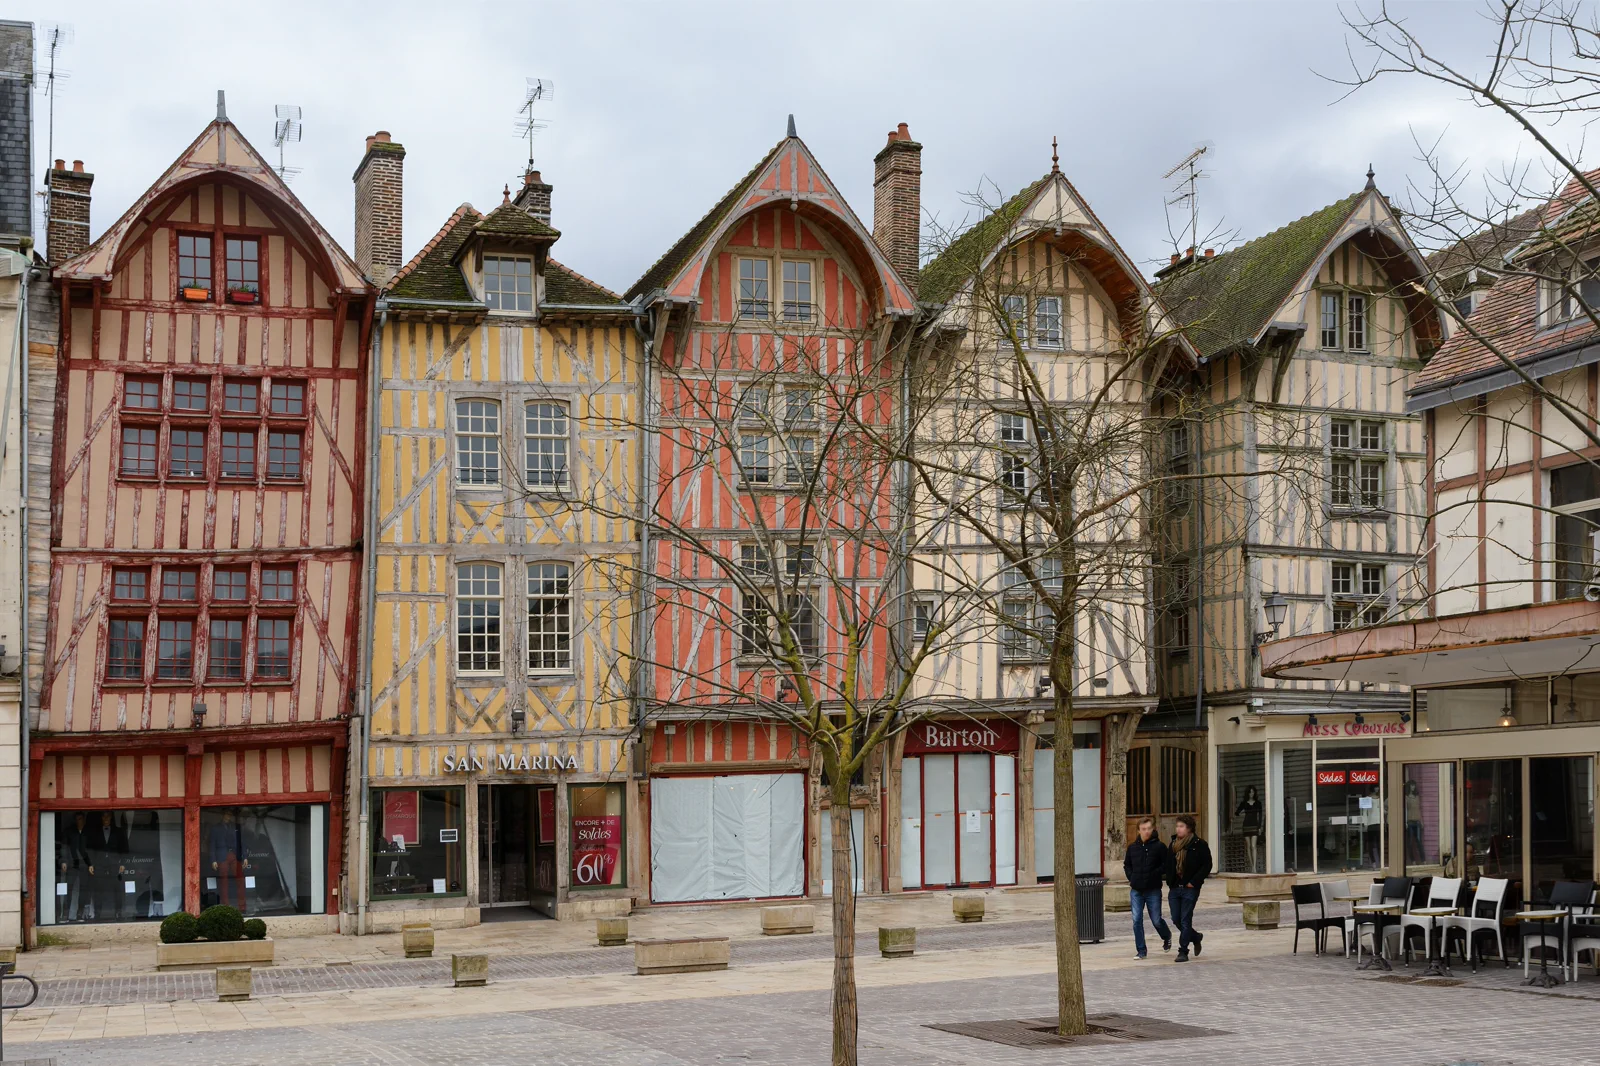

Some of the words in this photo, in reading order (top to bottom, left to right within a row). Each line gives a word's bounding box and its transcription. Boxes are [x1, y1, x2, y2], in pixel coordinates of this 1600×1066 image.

[925, 725, 995, 748] Burton
[443, 754, 485, 772] SAN
[497, 753, 579, 771] MARINA
[1319, 772, 1344, 783] Soldes
[1351, 771, 1377, 783] Soldes
